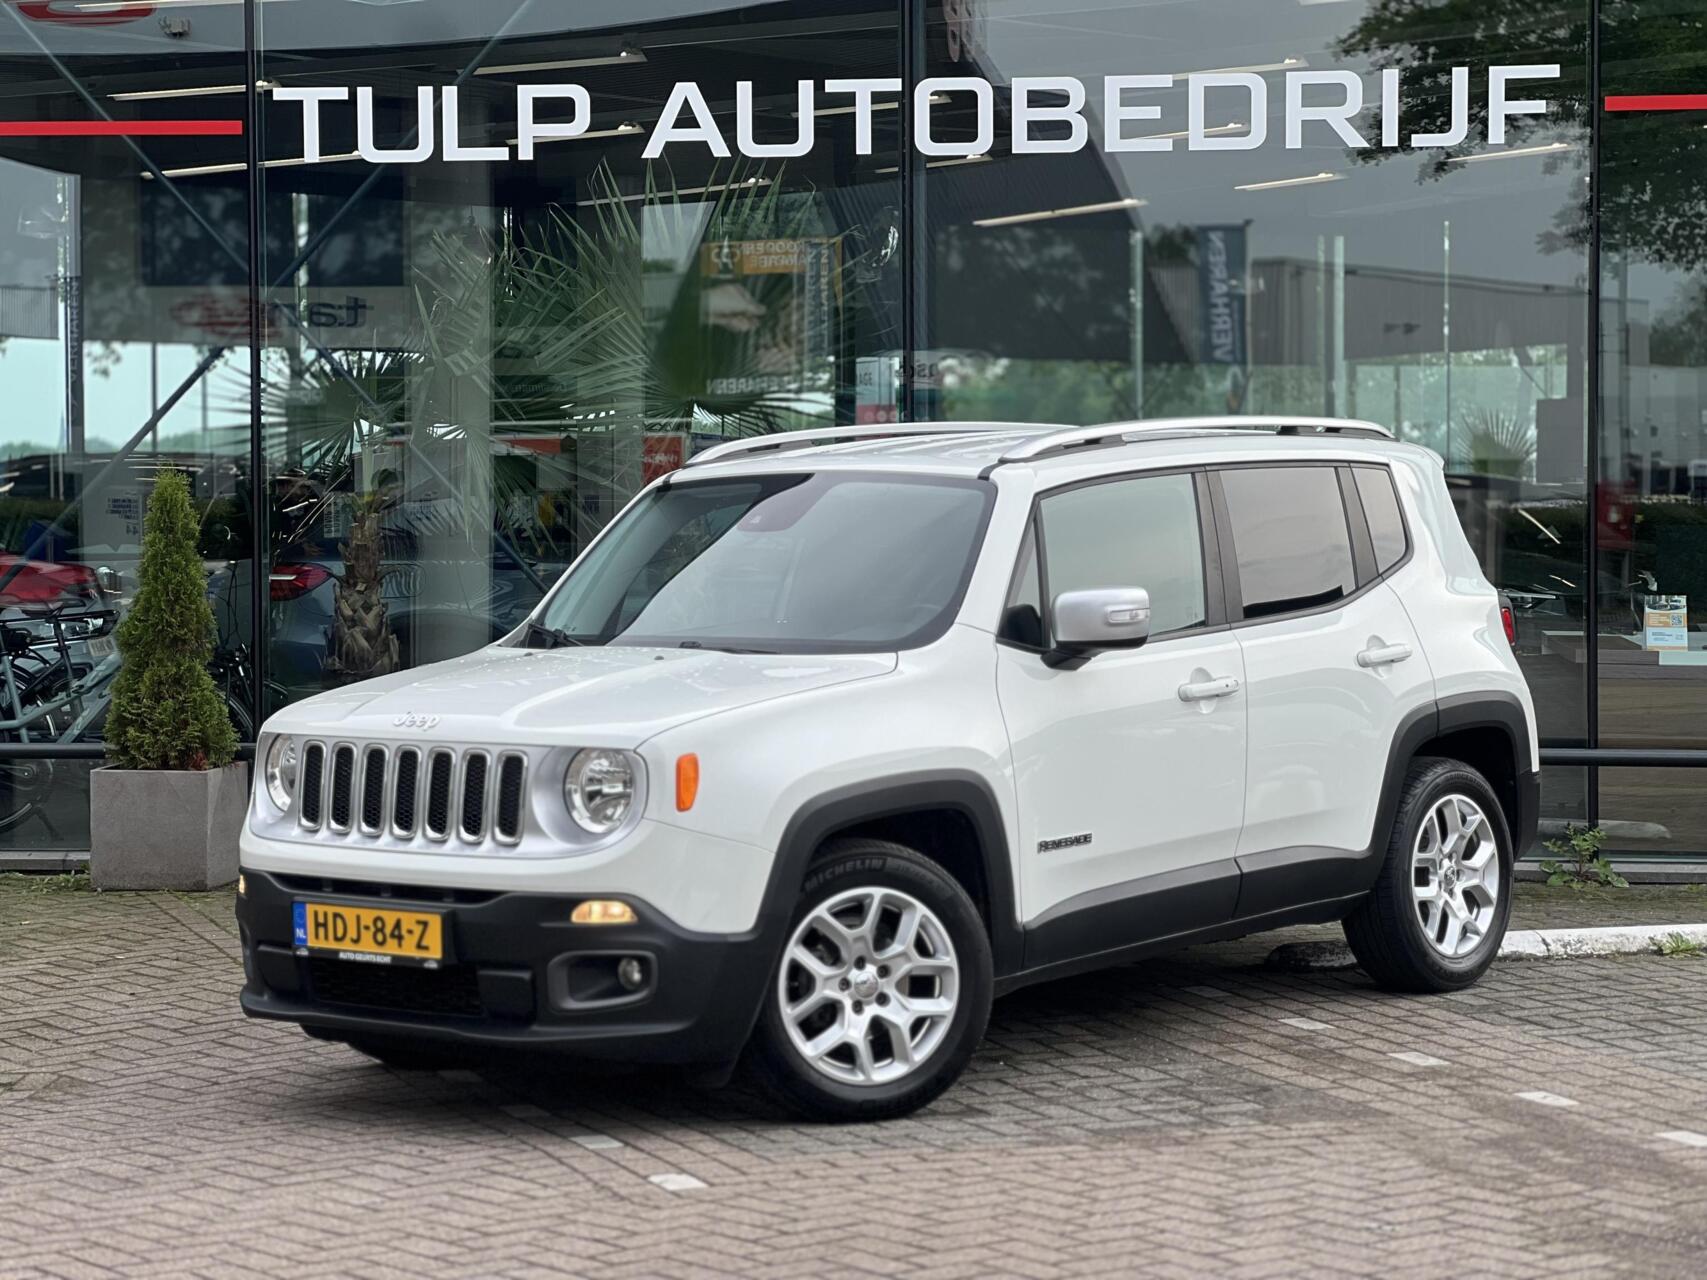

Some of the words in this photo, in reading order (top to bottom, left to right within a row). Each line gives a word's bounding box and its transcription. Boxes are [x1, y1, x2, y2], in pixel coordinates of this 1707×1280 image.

[273, 84, 591, 164] TULP
[641, 64, 1560, 159] AUTOBEDRIJF
[393, 711, 441, 732] Jeep
[1037, 832, 1093, 854] RENEGADE
[804, 858, 884, 892] MICHELIN
[296, 927, 307, 939] NL
[313, 909, 430, 951] HDJ-84-Z
